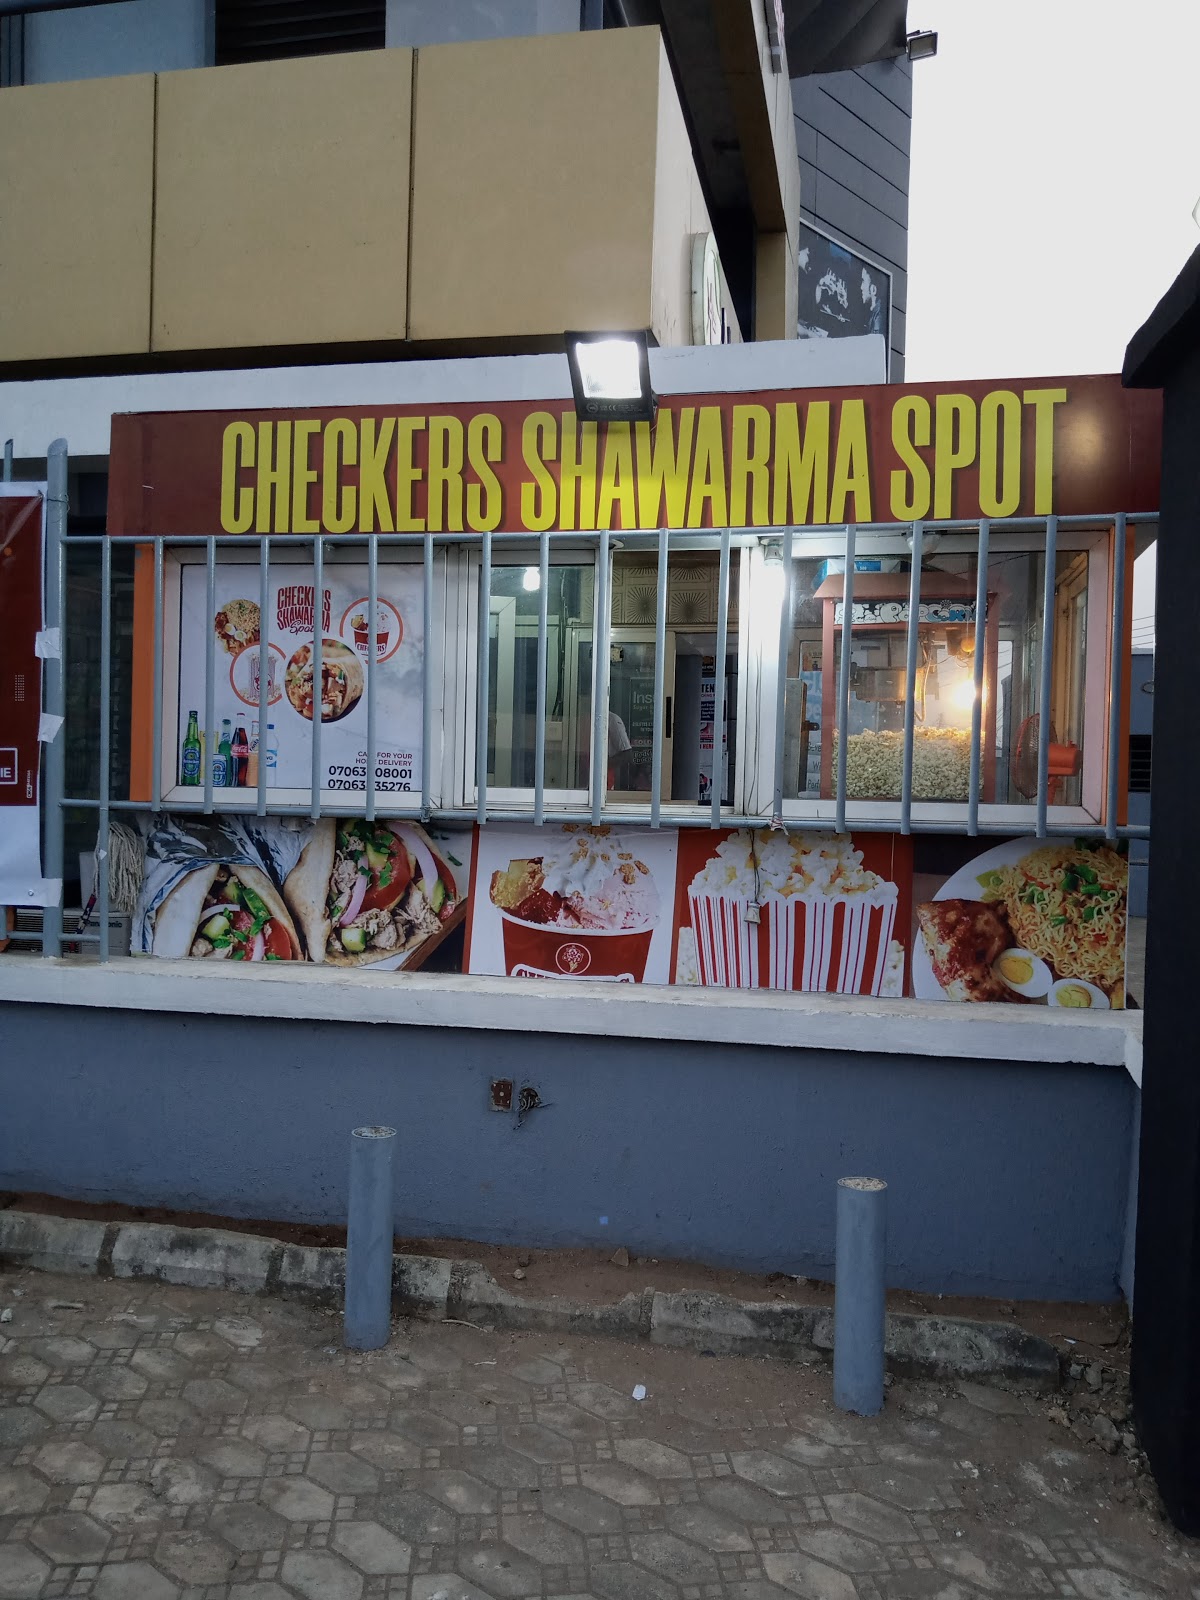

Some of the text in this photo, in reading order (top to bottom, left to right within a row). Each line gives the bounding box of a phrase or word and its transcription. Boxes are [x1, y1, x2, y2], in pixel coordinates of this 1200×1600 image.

[220, 388, 1067, 534] CHECKERS SHAWARMA SPOT
[329, 766, 412, 779] 0706308001
[328, 779, 411, 791] 0706335276
